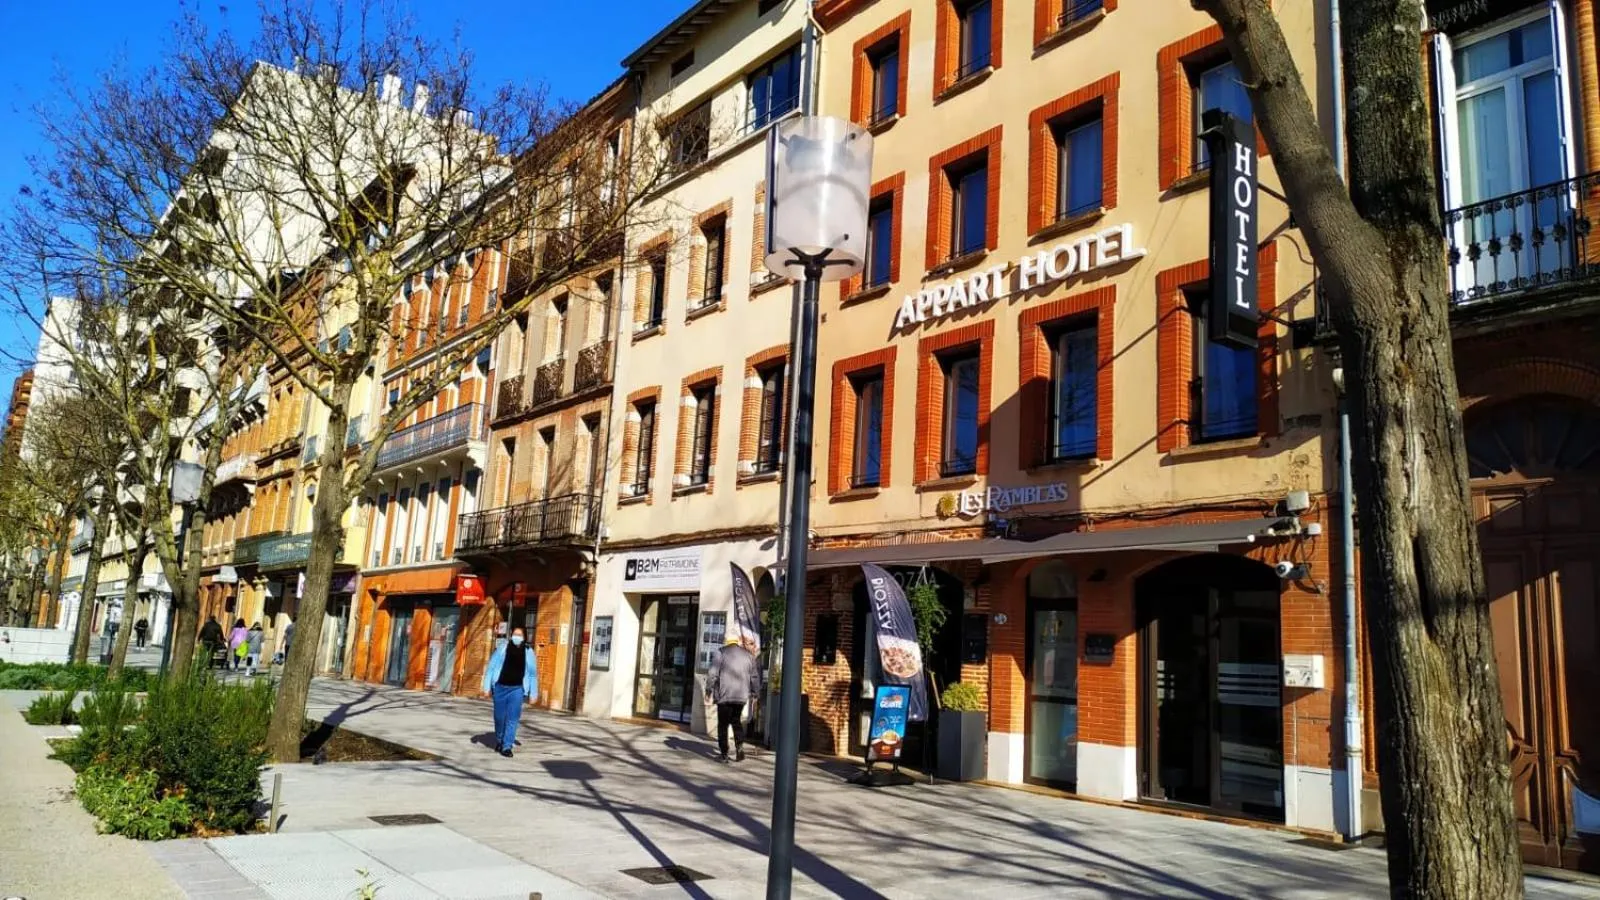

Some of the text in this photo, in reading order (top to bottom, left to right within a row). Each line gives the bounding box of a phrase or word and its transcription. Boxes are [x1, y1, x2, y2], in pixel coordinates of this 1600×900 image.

[1234, 141, 1252, 309] HOTEL
[895, 222, 1148, 328] APPART HOTEL
[986, 482, 1069, 512] RAMBLAS
[637, 558, 660, 573] B2M
